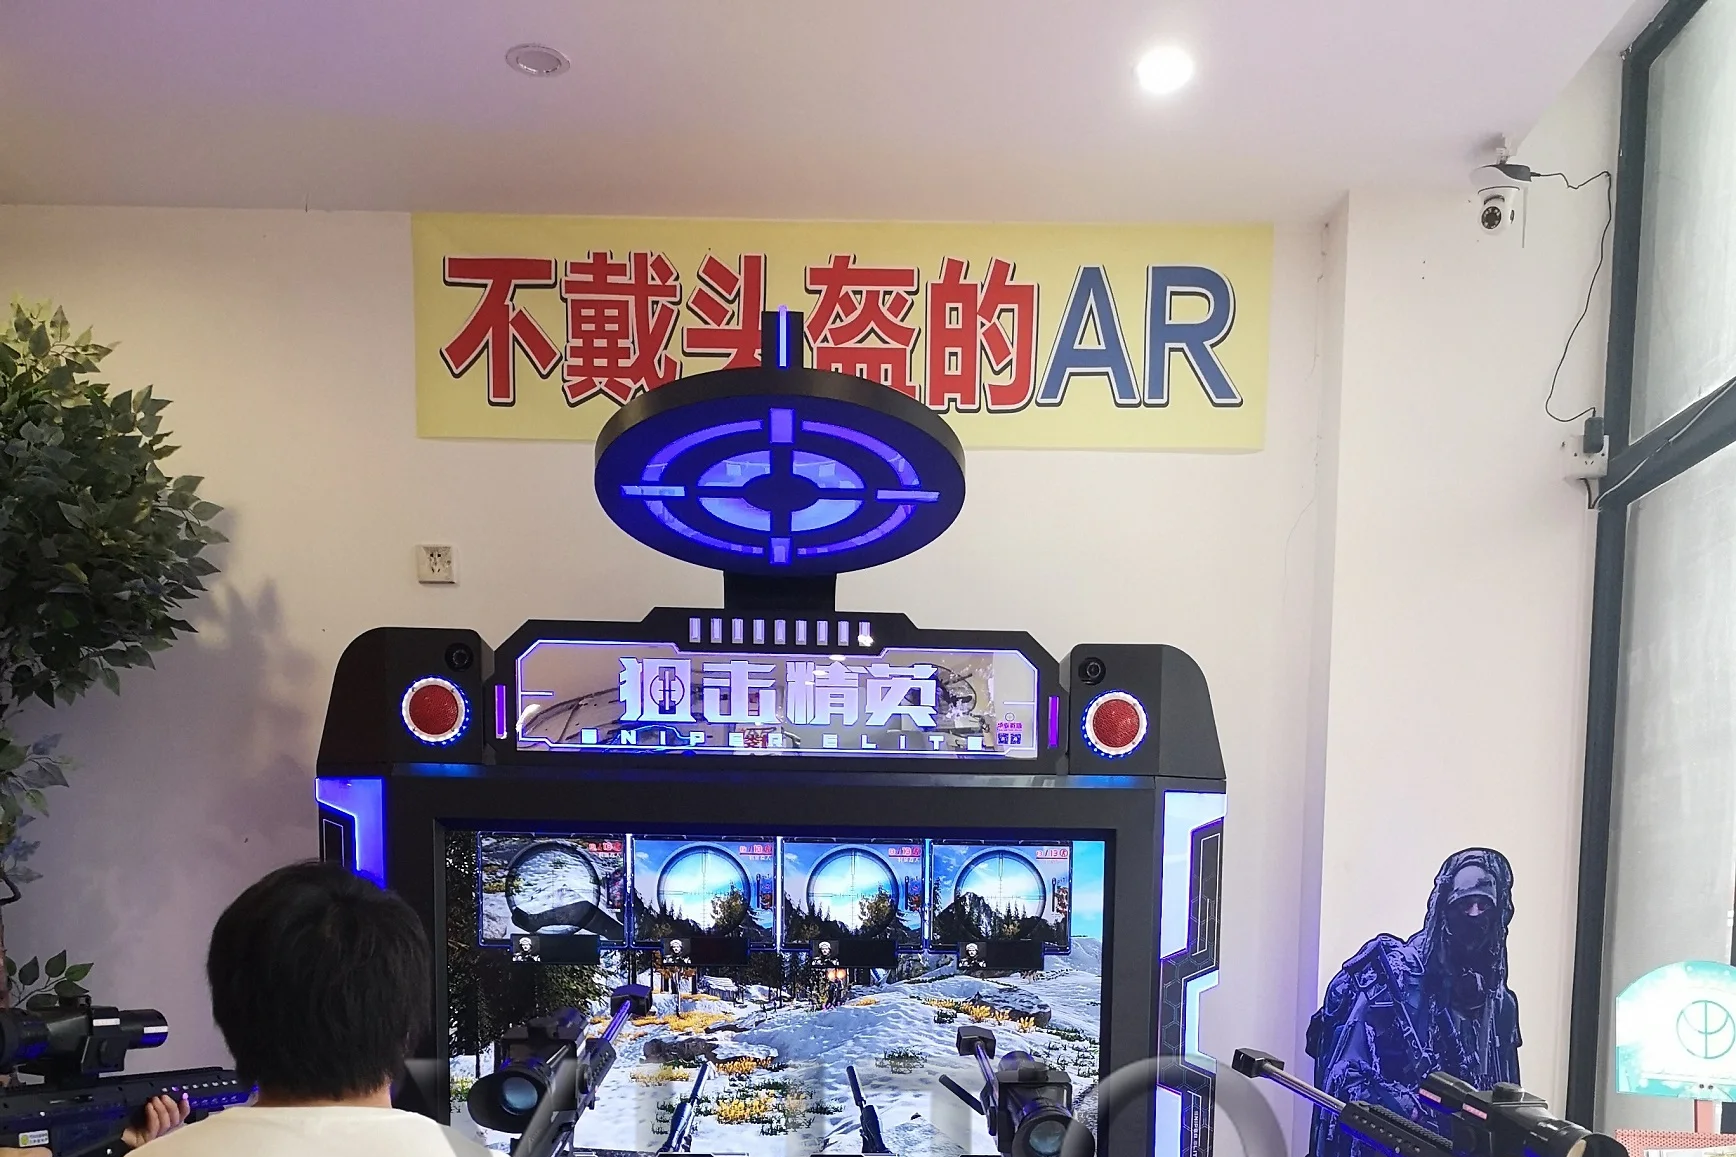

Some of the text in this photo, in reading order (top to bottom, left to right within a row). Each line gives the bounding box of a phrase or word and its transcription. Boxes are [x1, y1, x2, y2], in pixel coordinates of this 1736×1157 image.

[440, 250, 1243, 414] 不戴头盔的AR
[619, 656, 938, 727] 狙击精英
